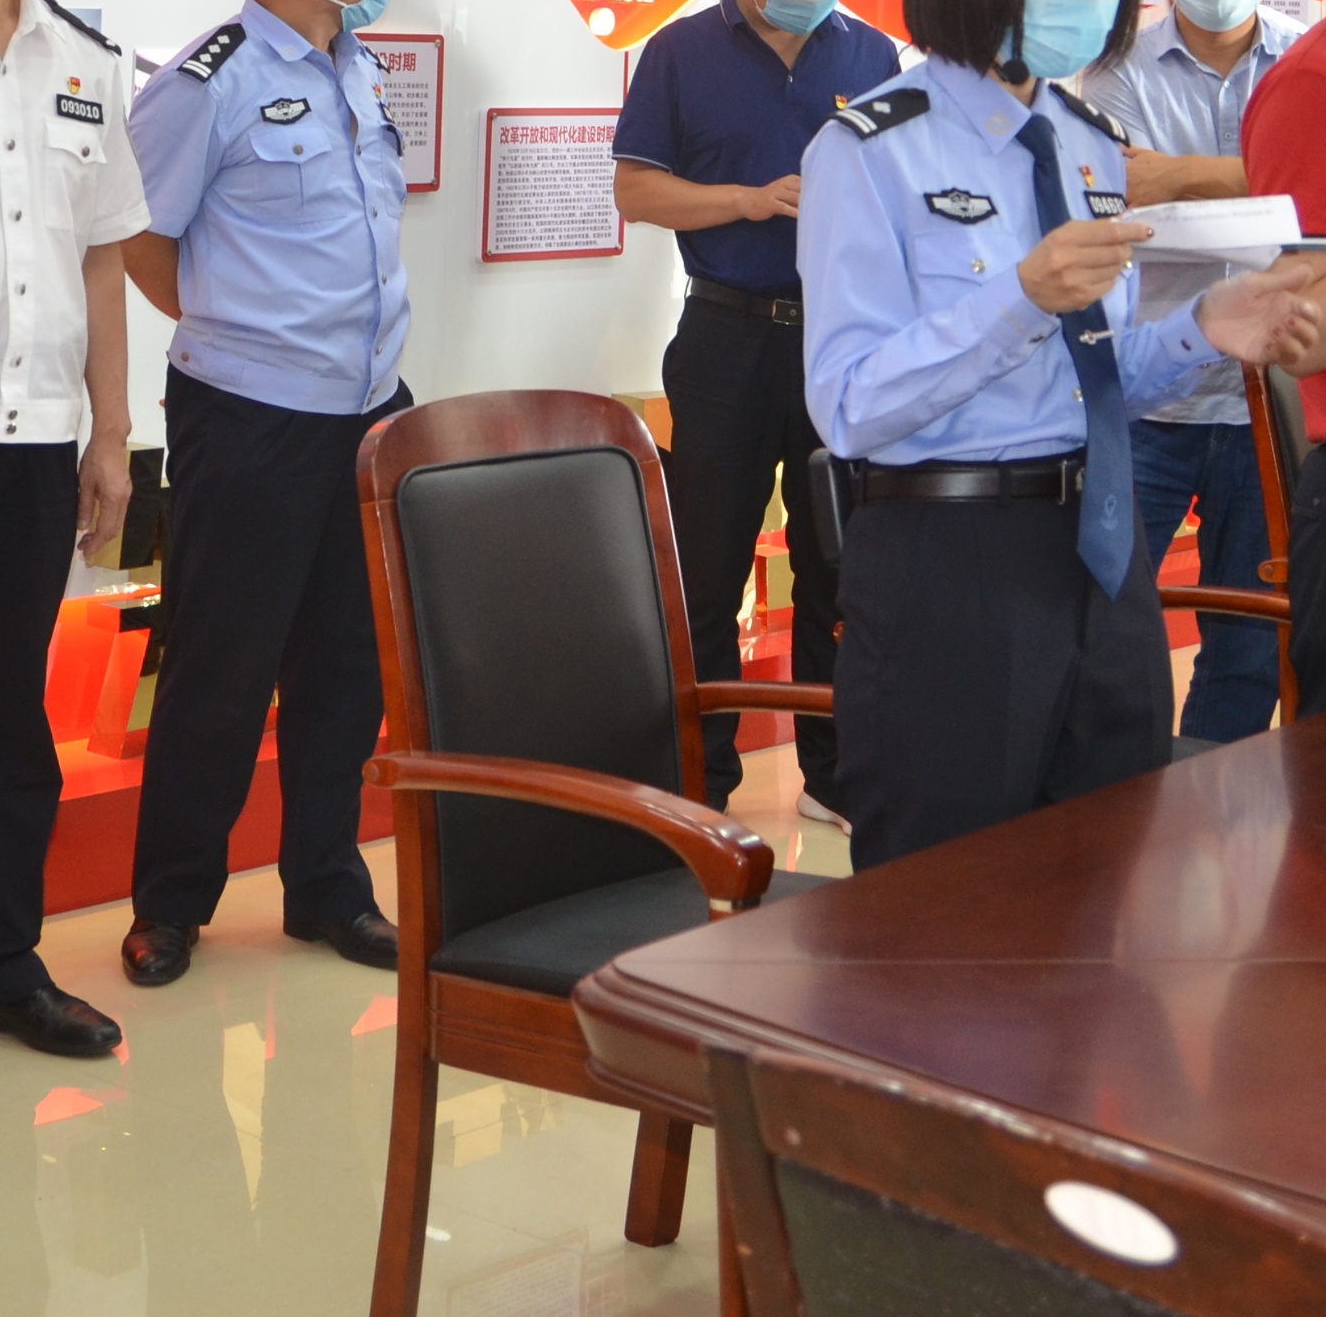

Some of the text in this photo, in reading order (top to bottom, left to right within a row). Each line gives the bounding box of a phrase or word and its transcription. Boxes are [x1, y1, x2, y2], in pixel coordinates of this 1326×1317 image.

[60, 98, 101, 121] 093010
[500, 125, 616, 145] 改革开放和现代化建设时期
